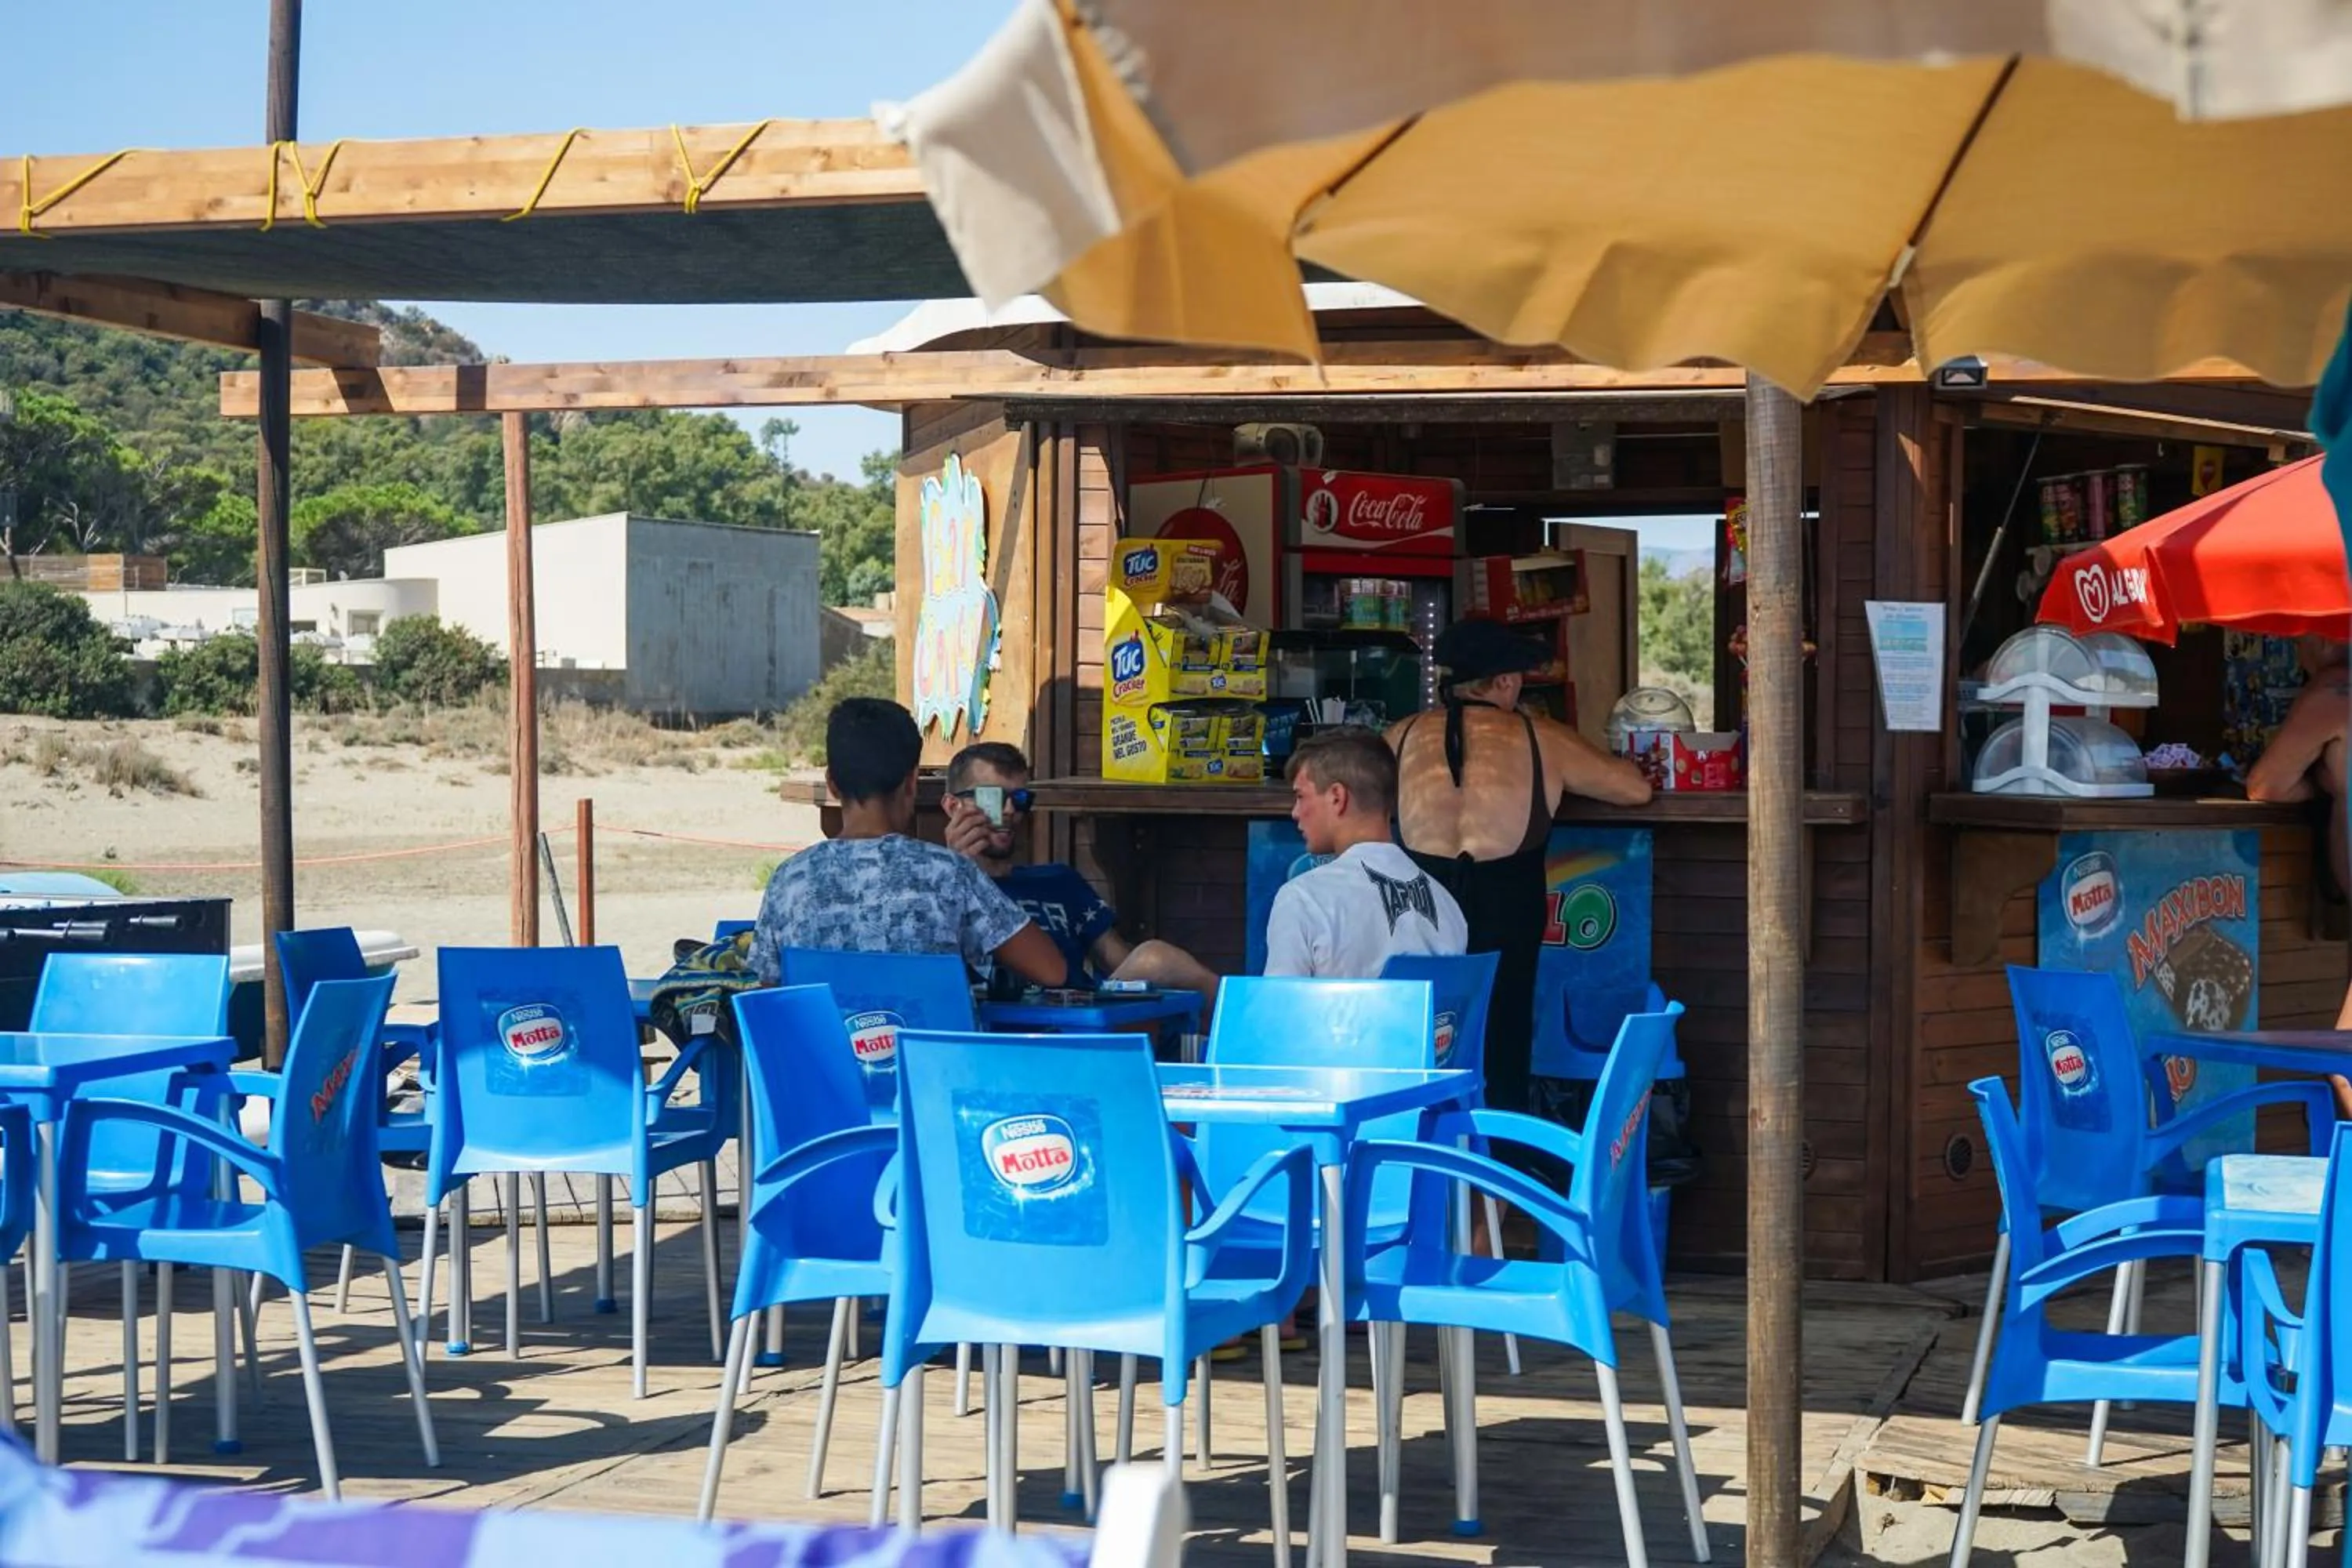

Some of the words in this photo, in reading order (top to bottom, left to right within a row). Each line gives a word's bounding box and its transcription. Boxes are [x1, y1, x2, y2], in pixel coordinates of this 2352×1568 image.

[1348, 489, 1428, 531] Coca-Cola
[2072, 883, 2112, 916] Motta
[2127, 873, 2248, 990] MAXIBON
[511, 1026, 561, 1048] Motta
[855, 1034, 895, 1054] Mott
[2056, 1054, 2083, 1076] Motta
[1001, 1146, 1069, 1174] Motta
